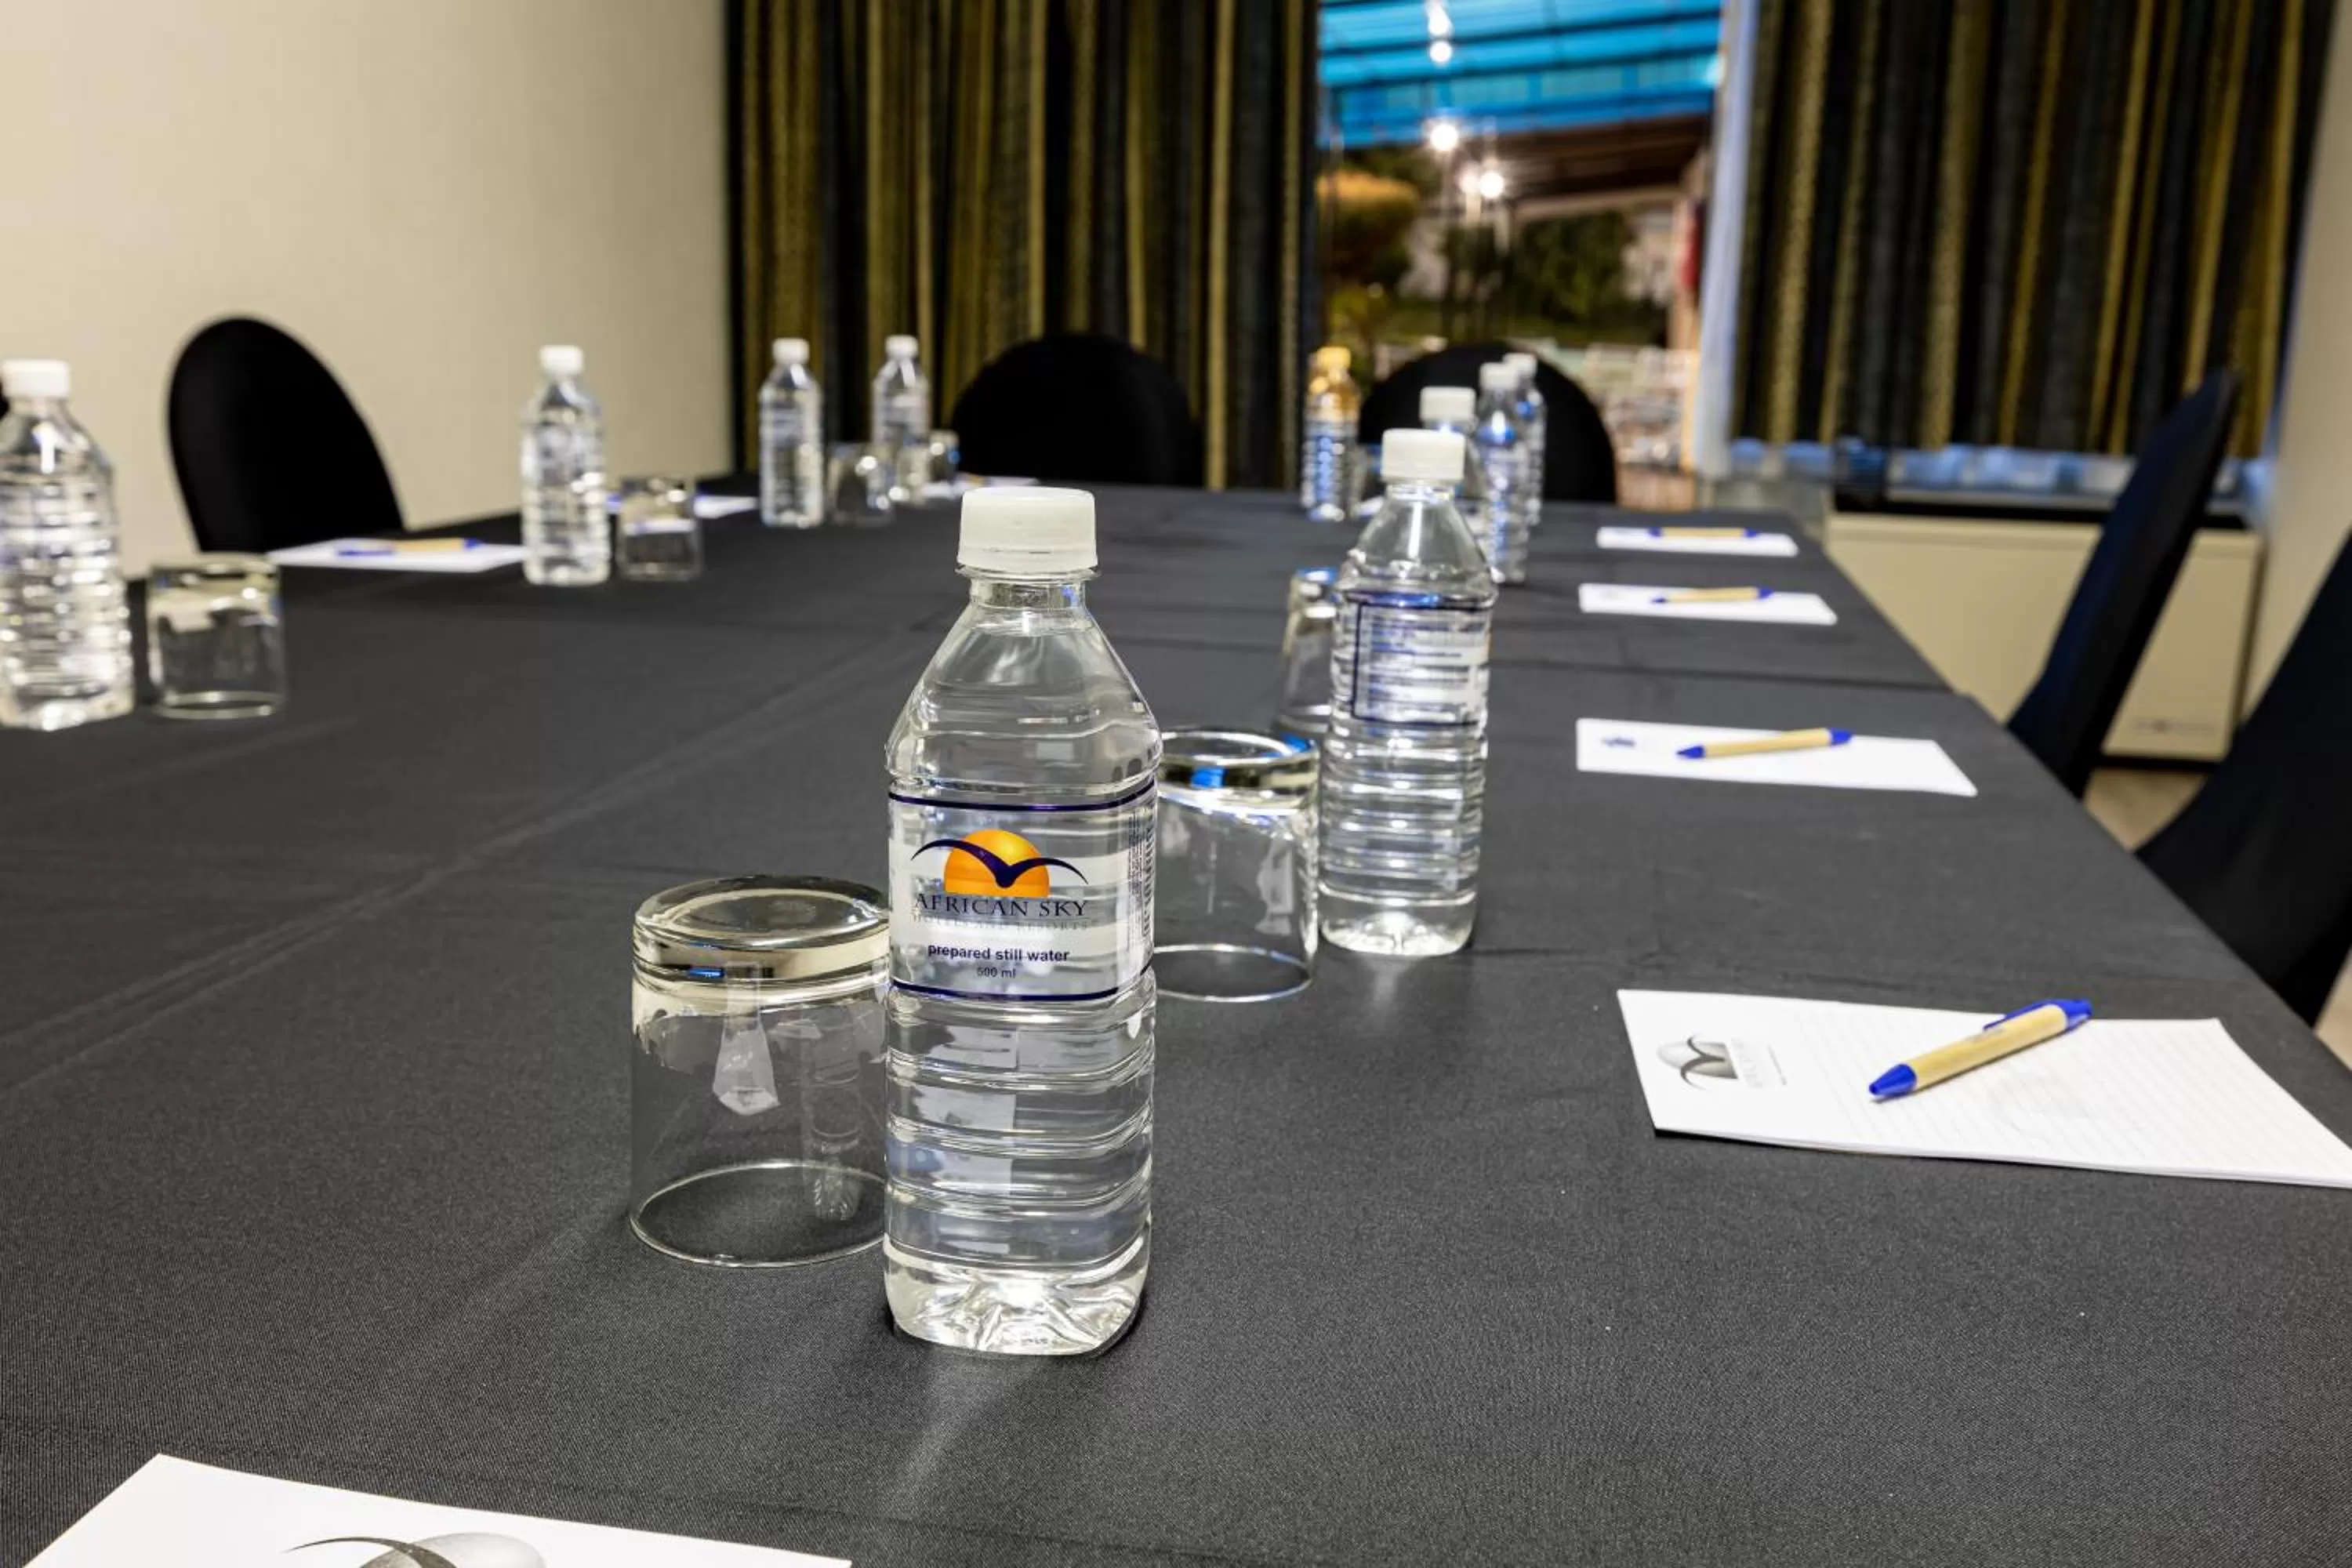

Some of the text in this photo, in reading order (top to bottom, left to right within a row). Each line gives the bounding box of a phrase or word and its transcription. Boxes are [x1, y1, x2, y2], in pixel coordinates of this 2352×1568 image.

[914, 893, 1090, 916] AFRICAN SKY
[928, 945, 1070, 962] prepared still water
[977, 967, 1016, 978] 500 ml
